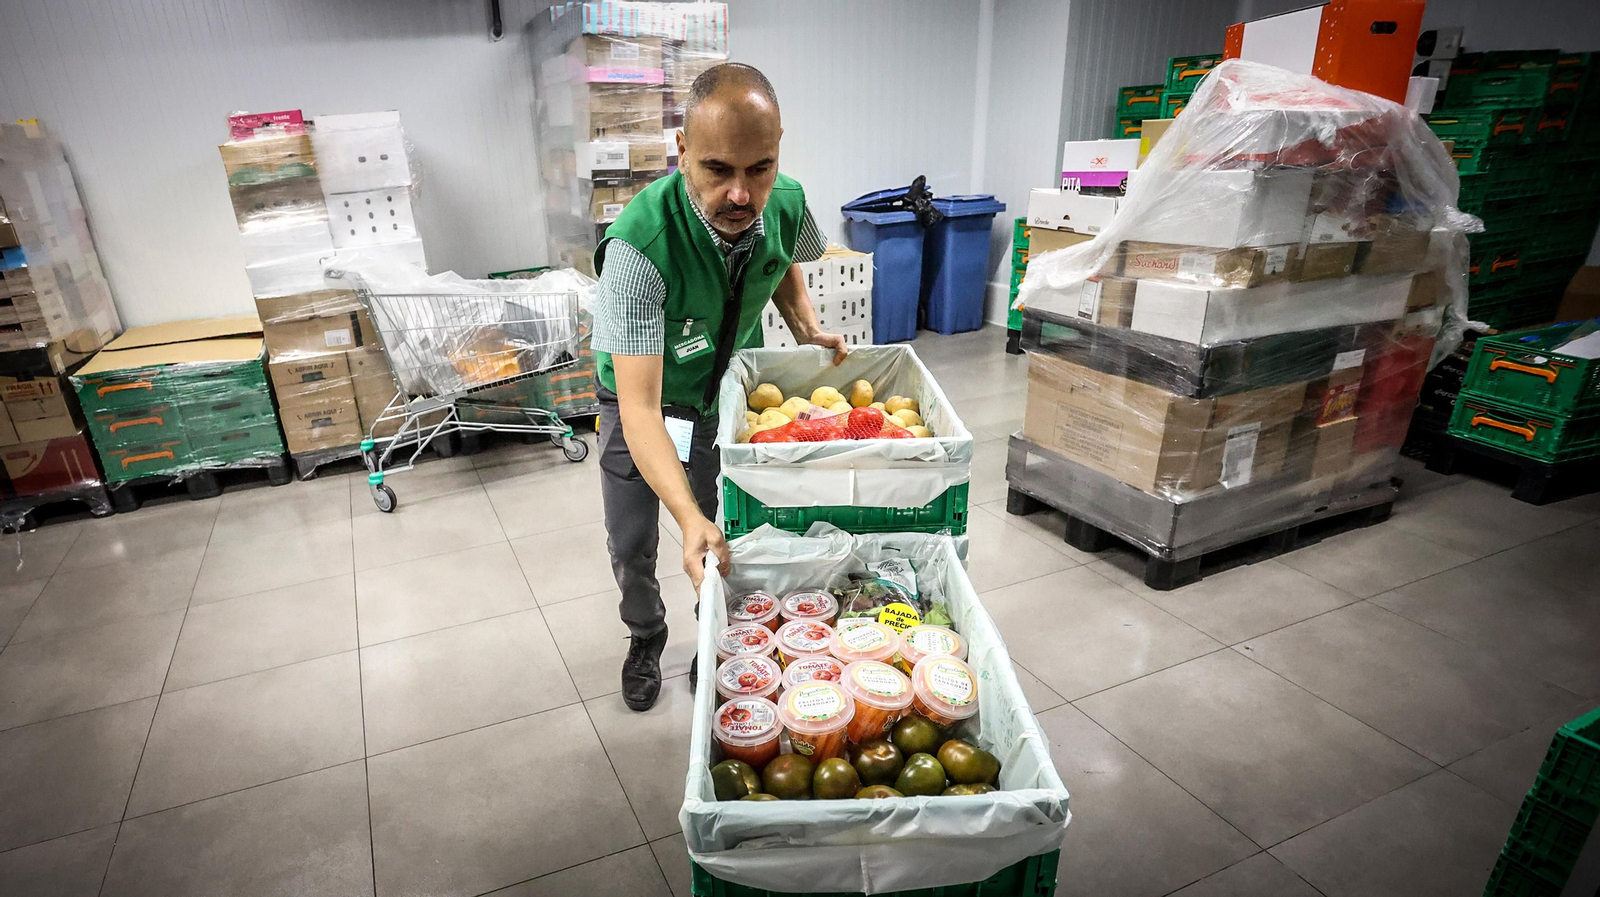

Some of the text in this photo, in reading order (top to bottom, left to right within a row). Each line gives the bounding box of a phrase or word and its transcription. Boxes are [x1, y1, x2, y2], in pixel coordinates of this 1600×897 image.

[1062, 177, 1081, 192] PITA
[1134, 254, 1178, 271] Suchard
[674, 334, 705, 350] MERCADONA
[686, 344, 699, 352] JUAN
[6, 383, 34, 392] FRAGIL
[884, 607, 918, 620] BAJADA
[726, 628, 754, 638] TOMATE
[785, 624, 806, 638] TOMATE
[748, 660, 770, 678] TOMATE
